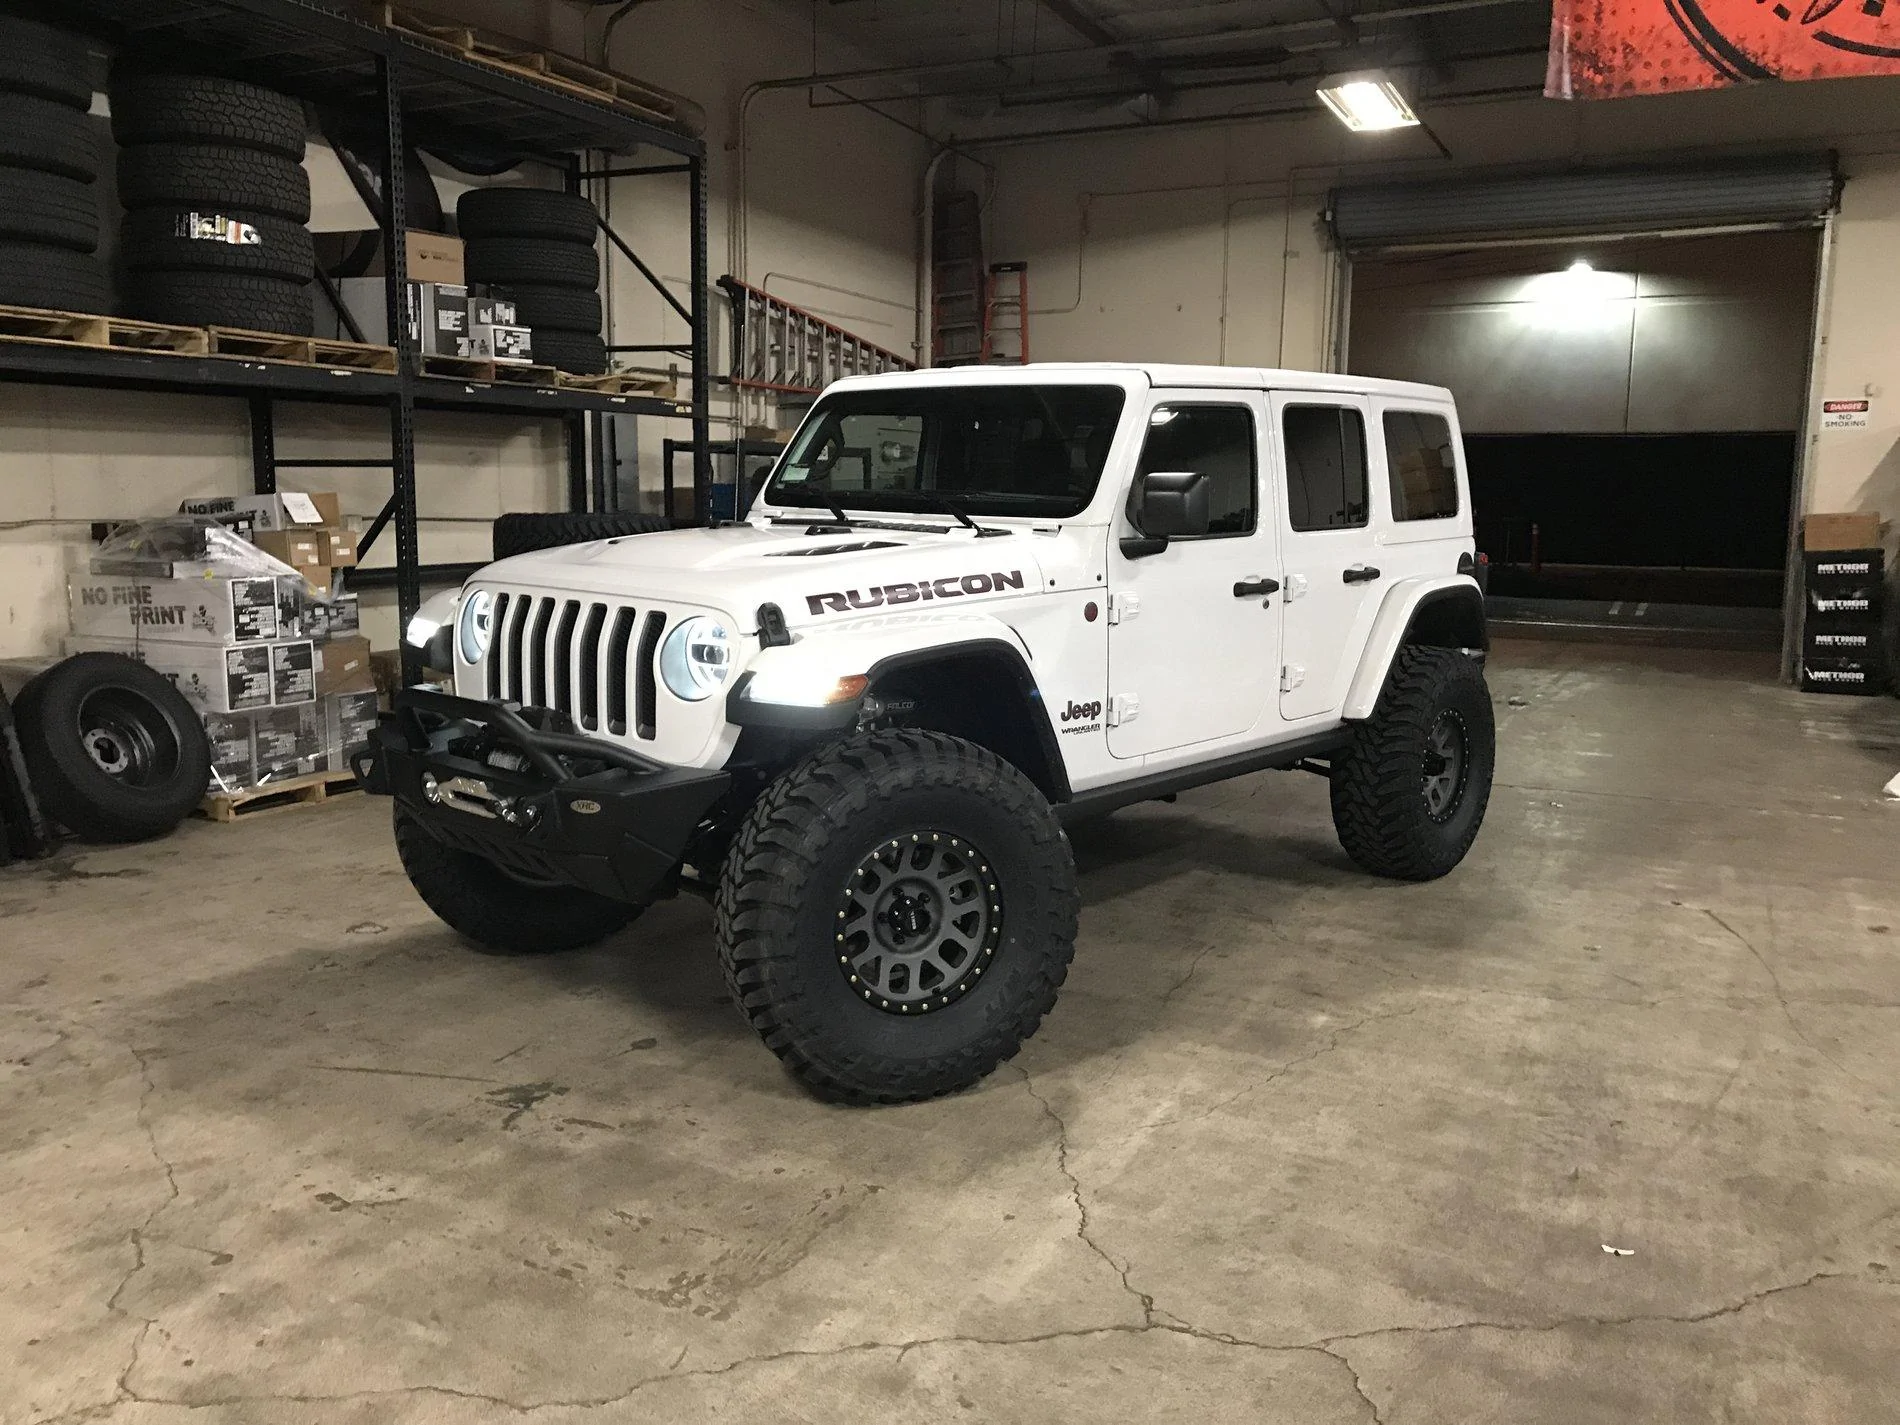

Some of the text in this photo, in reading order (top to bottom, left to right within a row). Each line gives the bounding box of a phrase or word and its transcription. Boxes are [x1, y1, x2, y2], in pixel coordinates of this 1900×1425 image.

[187, 504, 207, 515] NO
[81, 586, 152, 605] NO FINE
[805, 570, 1024, 616] RUBICON
[129, 605, 186, 625] PRINT
[1060, 700, 1102, 722] Jeep
[1061, 724, 1101, 734] WRANGLER
